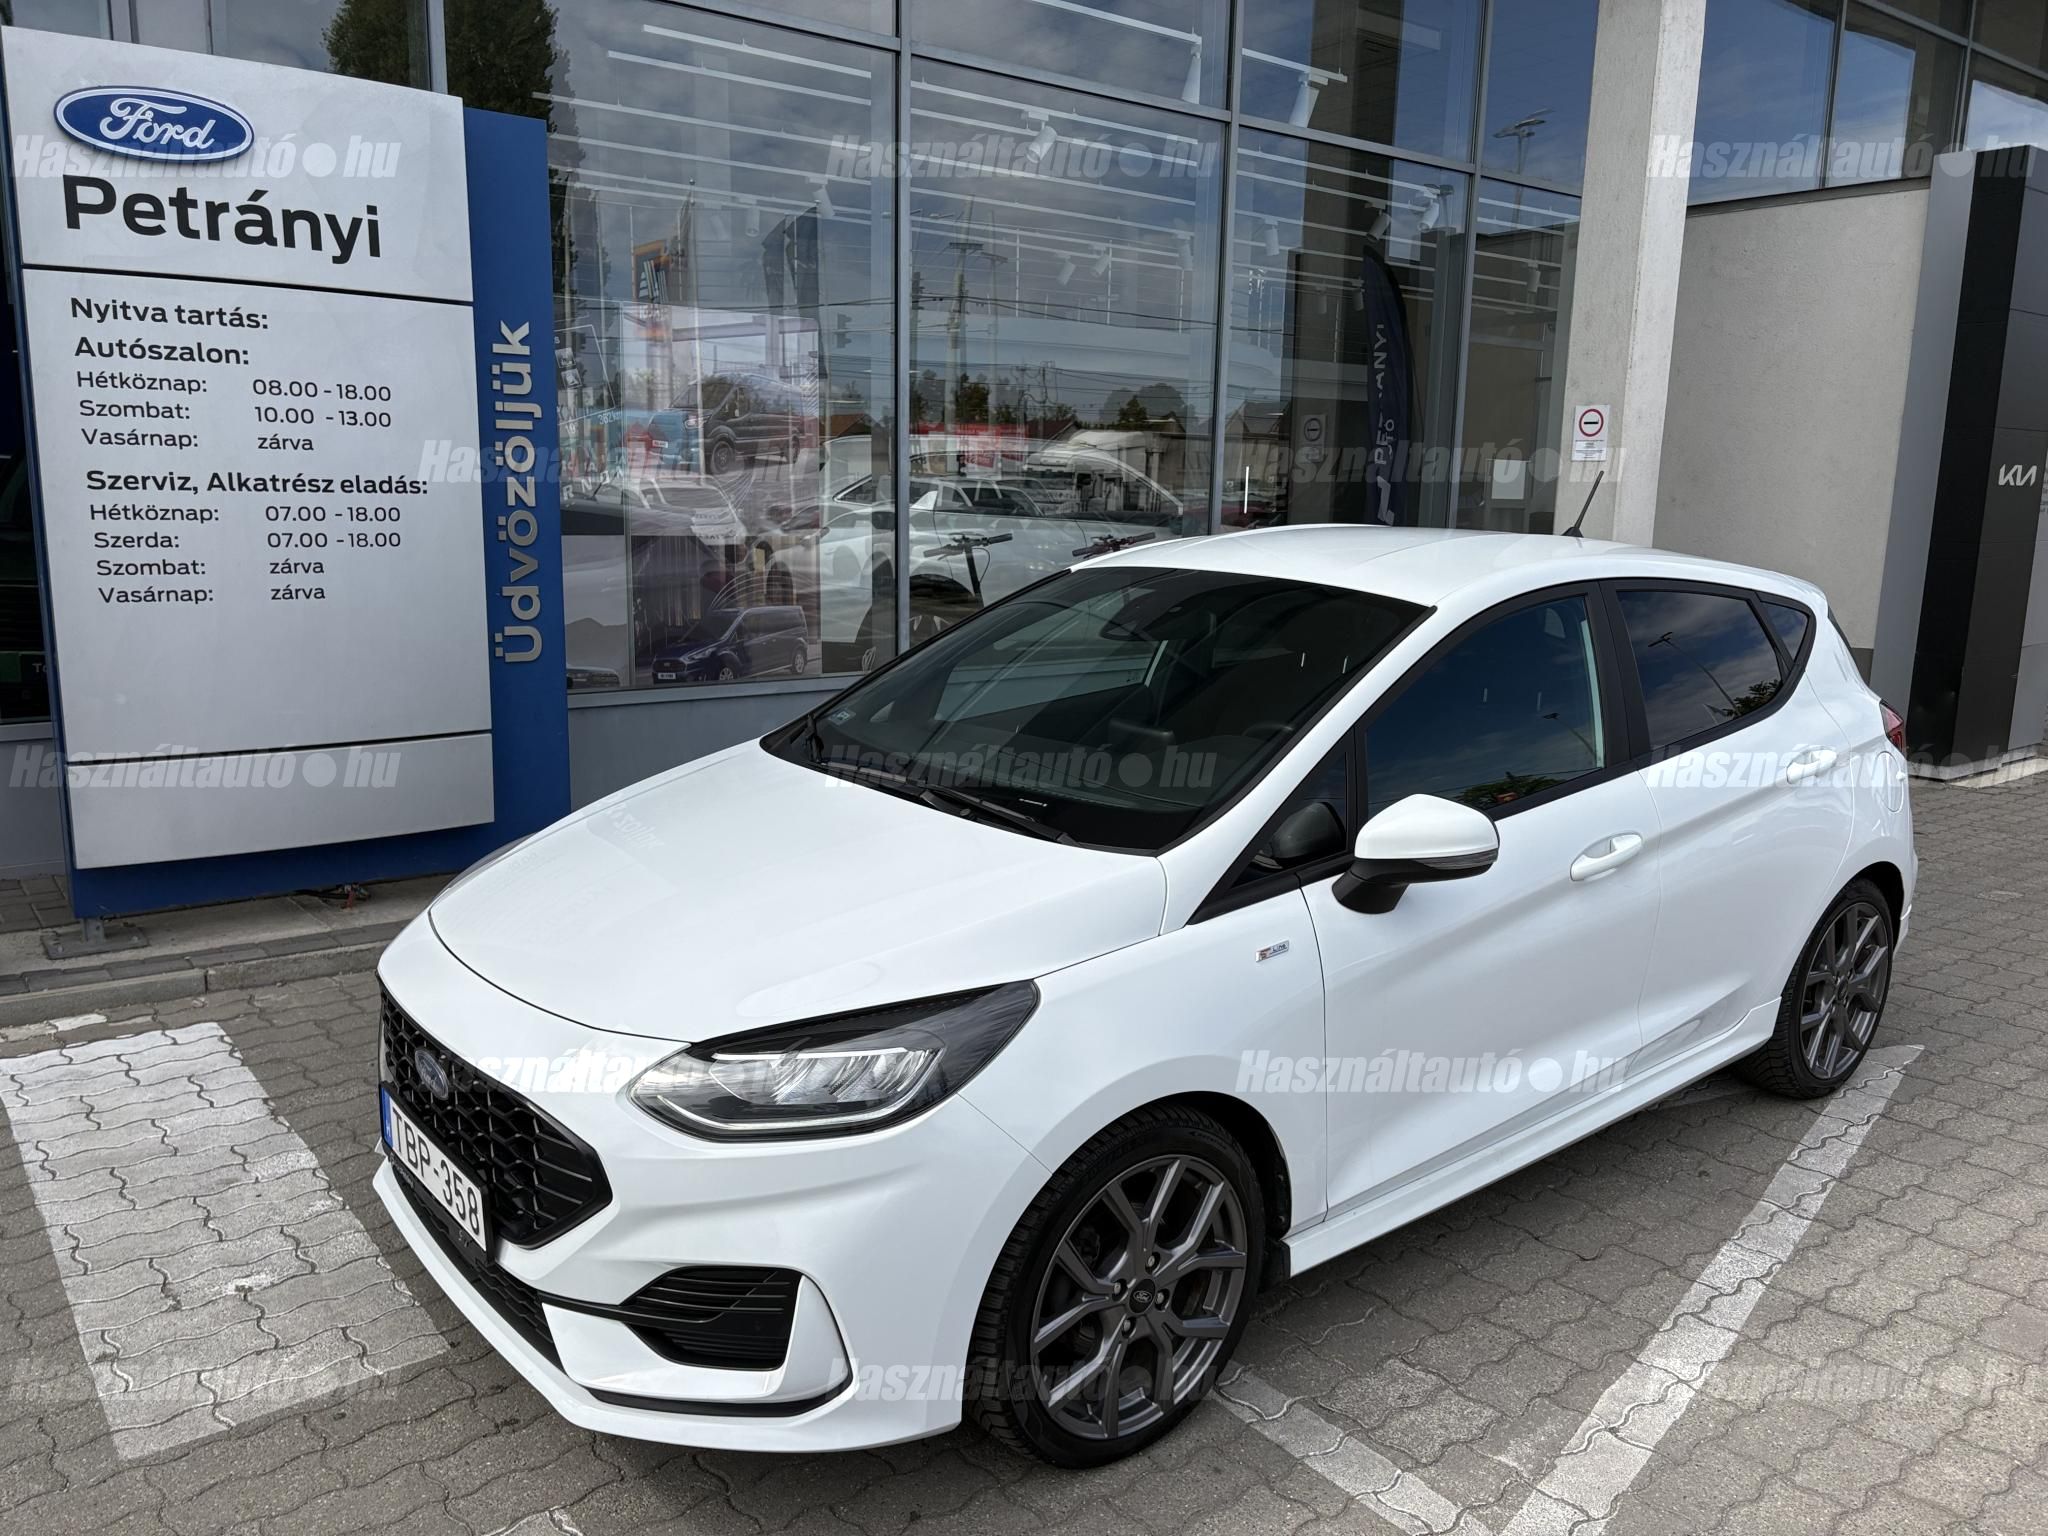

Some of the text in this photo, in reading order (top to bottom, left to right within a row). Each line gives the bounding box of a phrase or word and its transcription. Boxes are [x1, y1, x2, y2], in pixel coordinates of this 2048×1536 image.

[98, 96, 217, 151] Ford
[62, 174, 381, 265] Petrányi
[70, 297, 269, 330] Nyitva tartás:
[74, 336, 249, 365] Autószalon:
[76, 370, 207, 395] Hétköznap:
[252, 378, 318, 399] 08.00
[79, 400, 190, 420] Szombat:
[254, 406, 315, 425] 10.00
[81, 428, 313, 451] Vasárnap: zárva
[86, 470, 428, 495] Szerviz, Alkatrész eladás:
[492, 320, 542, 663] Üdvözöljük
[90, 503, 219, 524] Hétköznap:
[265, 505, 326, 522] 07.00
[94, 531, 180, 549] Szerda:
[267, 532, 328, 548] 07.00
[96, 558, 325, 576] Szombat: zárva
[98, 583, 326, 605] Vasárnap: zárva
[393, 1107, 480, 1237] TBP-358
